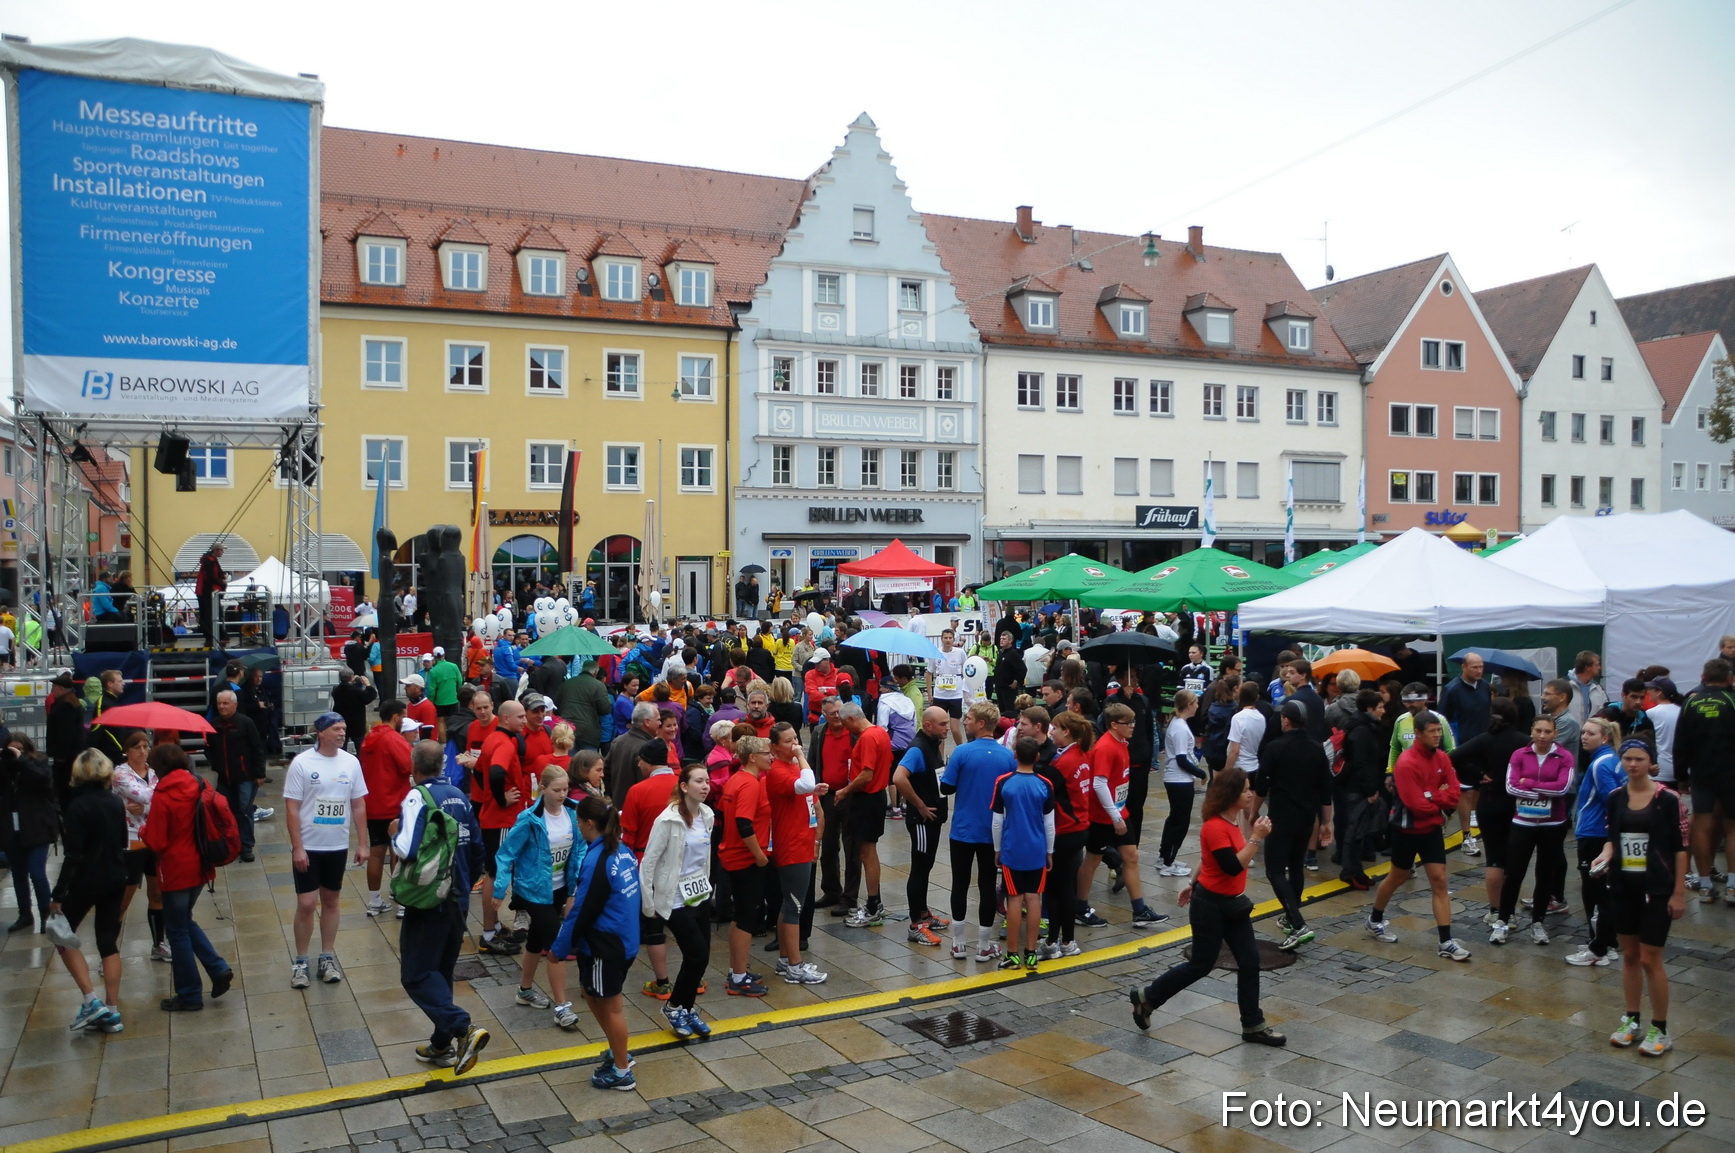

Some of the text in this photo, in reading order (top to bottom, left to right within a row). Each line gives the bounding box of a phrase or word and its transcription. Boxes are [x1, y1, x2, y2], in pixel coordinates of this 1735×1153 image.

[79, 99, 258, 137] Messeauftritte
[52, 119, 279, 153] Hauptversammlungen Get together
[131, 143, 240, 169] Roadshows
[72, 156, 264, 189] Sportveranstaltungen
[52, 172, 283, 207] Installationen TV-Produktionen
[71, 197, 217, 220] Kulturveranstaltungen
[79, 224, 253, 253] Firmeneröffnungen
[108, 260, 217, 285] Kongresse
[118, 290, 200, 309] Konzerte
[165, 284, 211, 296] Musicals
[139, 306, 189, 317] Tourservice
[103, 334, 238, 351] www.barowski-ag.de
[120, 376, 225, 394] BAROWSKI
[231, 380, 259, 396] AG
[821, 413, 917, 430] BRILLEN WEBER
[808, 507, 925, 523] BRILLEN WEBER
[813, 549, 857, 557] BRILLEN WEBER
[318, 804, 344, 817] 3180
[684, 877, 709, 896] 5083
